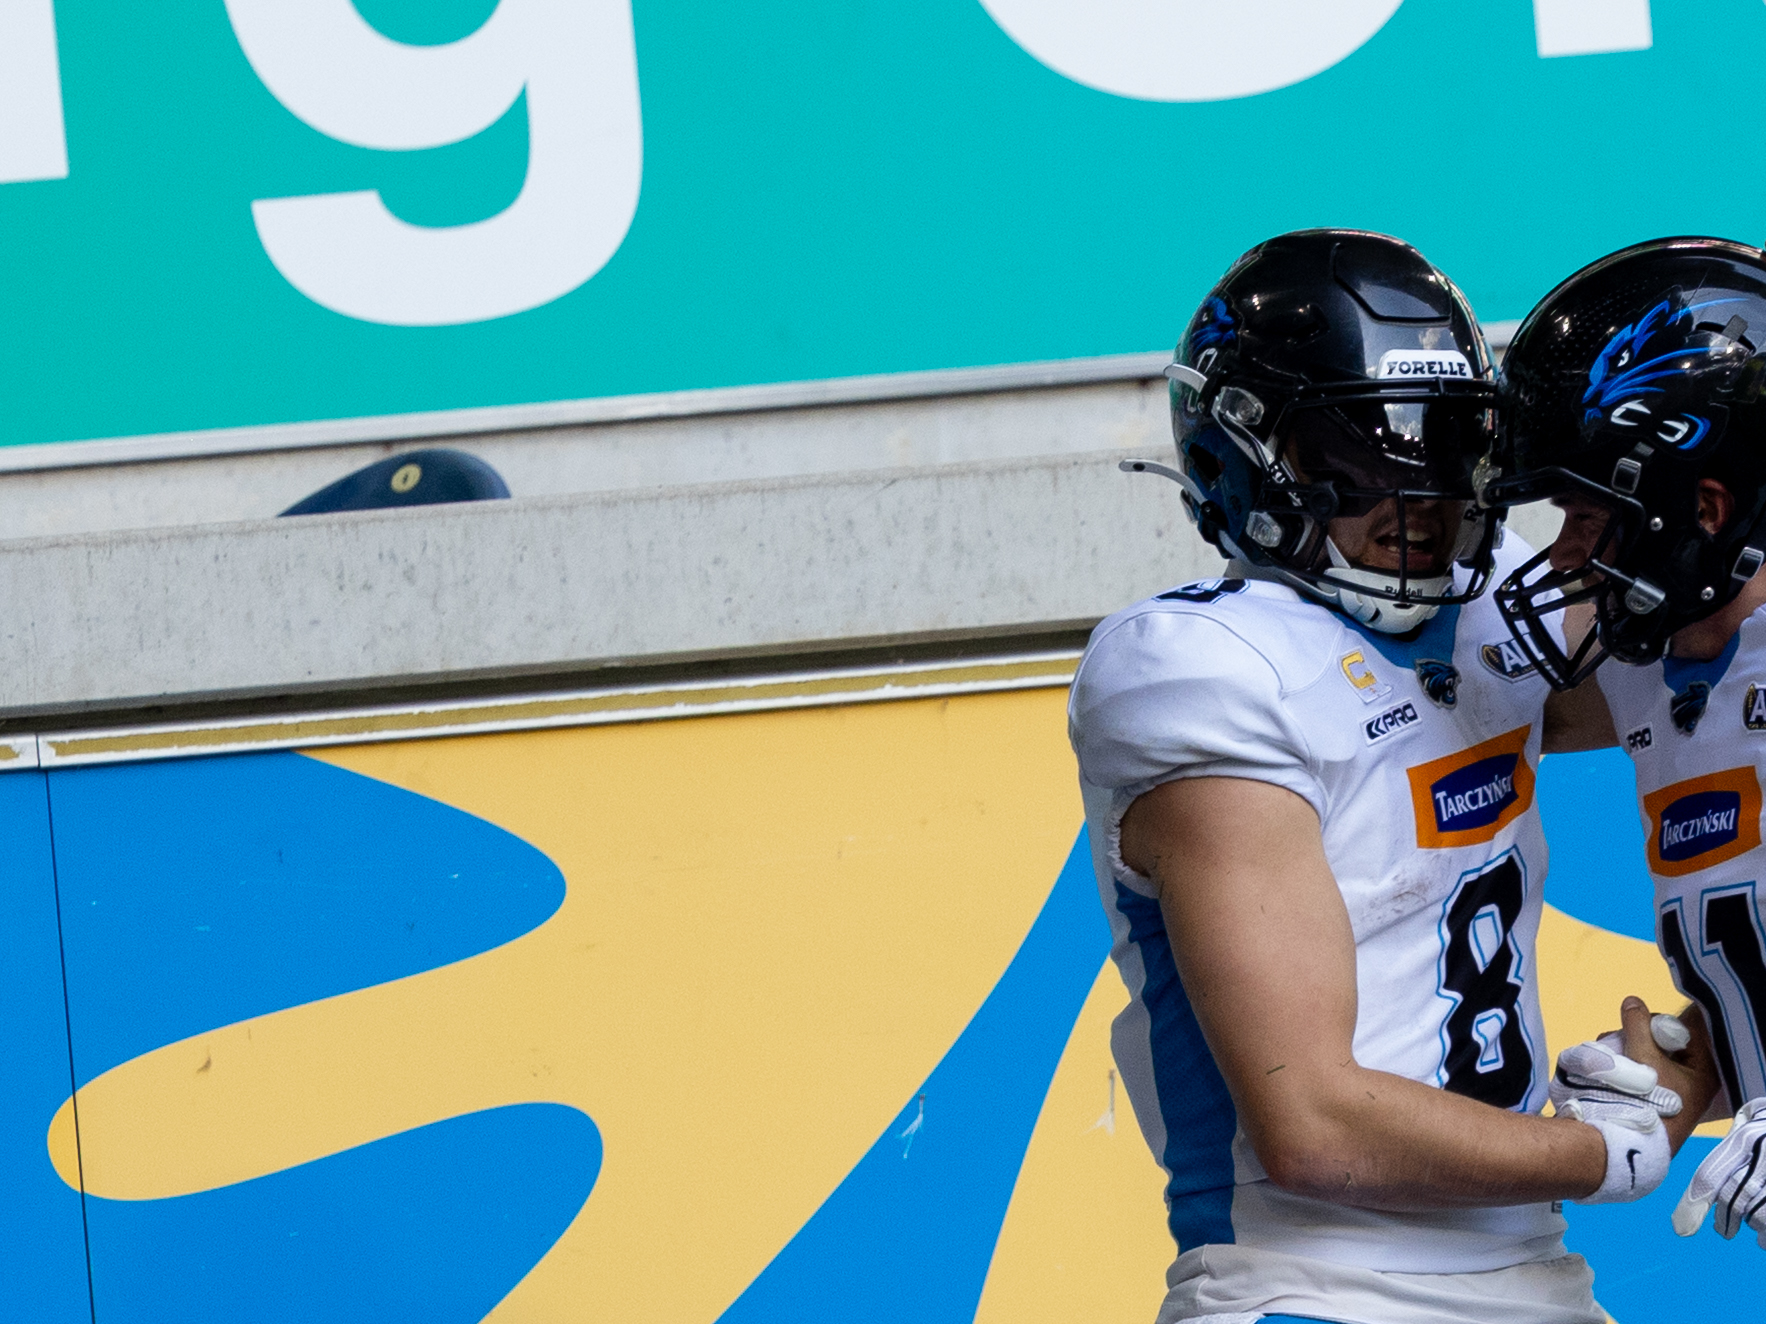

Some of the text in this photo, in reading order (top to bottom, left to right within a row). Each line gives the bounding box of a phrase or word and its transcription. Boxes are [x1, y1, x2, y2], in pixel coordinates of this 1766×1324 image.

[1386, 360, 1468, 377] FORELLE
[1341, 651, 1377, 689] C
[1662, 807, 1736, 850] TARCZYŃSKI
[1438, 846, 1535, 1112] 8
